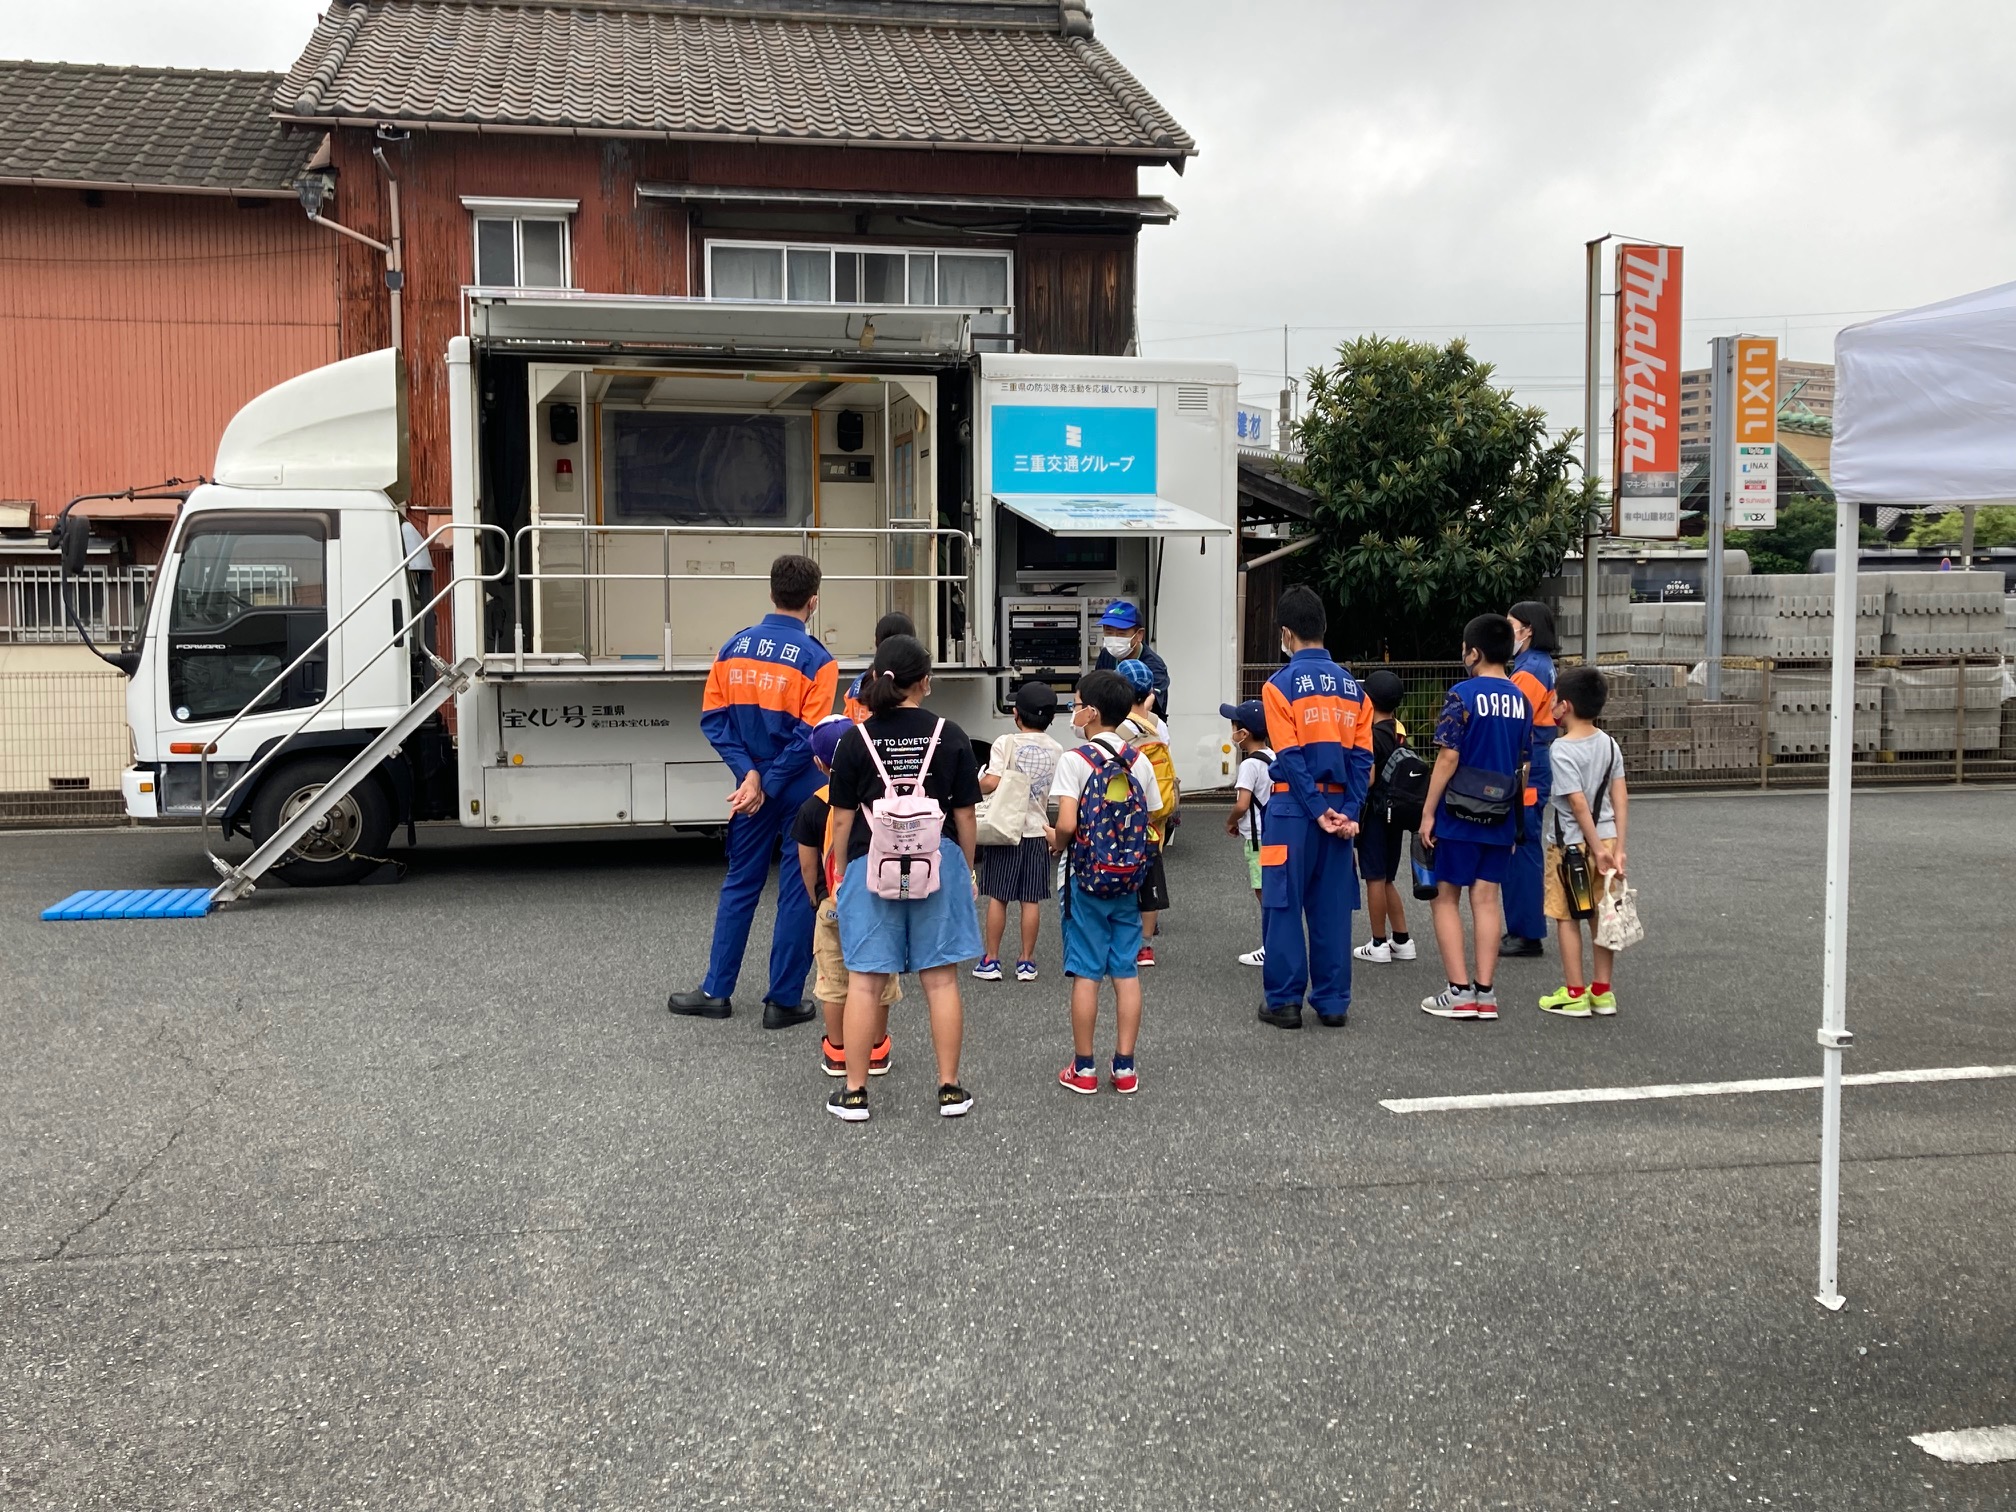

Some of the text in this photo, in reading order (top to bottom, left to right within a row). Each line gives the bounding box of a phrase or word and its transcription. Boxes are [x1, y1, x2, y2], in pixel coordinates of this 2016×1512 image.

[1624, 247, 1669, 472] makita
[1000, 382, 1148, 395] 三重県の防災啓発活動を応援しています
[1742, 347, 1772, 435] LIXIL
[1013, 454, 1136, 473] 三重交通グループ
[1750, 462, 1769, 470] INAX
[733, 636, 800, 663] 消防団
[728, 667, 790, 693] 四日市市
[1295, 674, 1358, 697] 消防団
[502, 705, 587, 729] 宝くじ号
[591, 705, 625, 716] 三重県
[897, 736, 942, 746] LOVETOC
[1455, 810, 1493, 824] beruf
